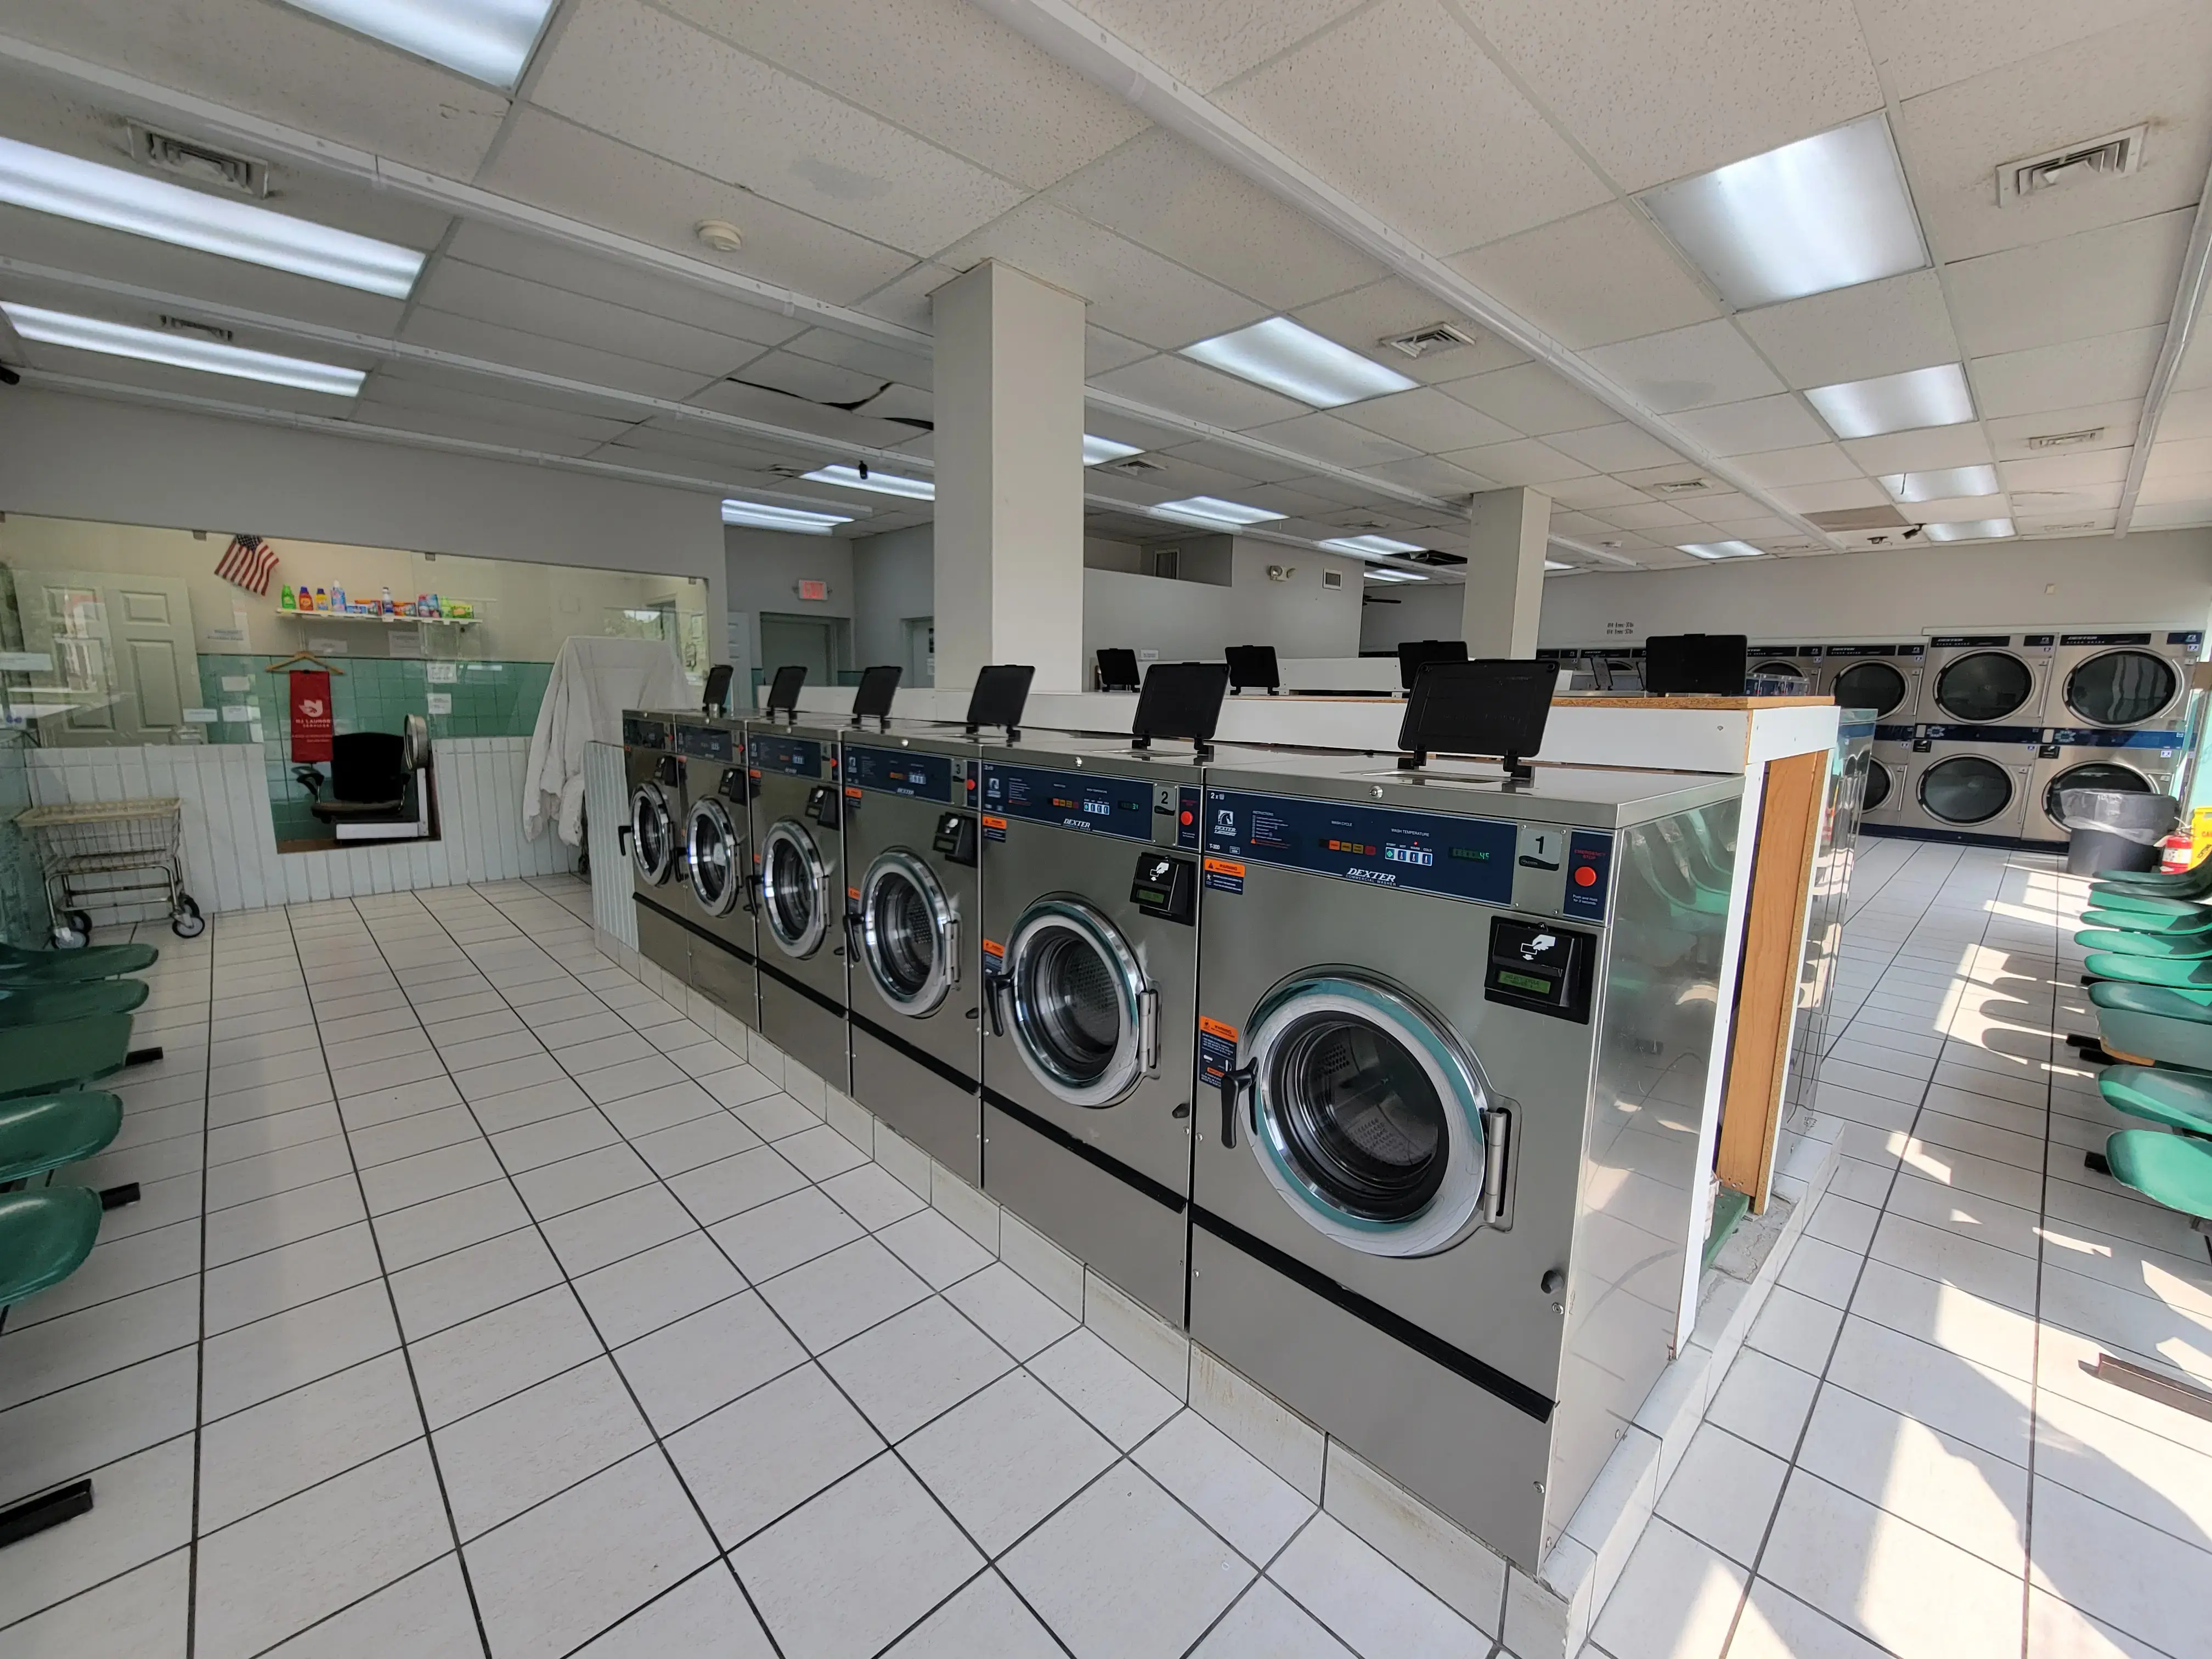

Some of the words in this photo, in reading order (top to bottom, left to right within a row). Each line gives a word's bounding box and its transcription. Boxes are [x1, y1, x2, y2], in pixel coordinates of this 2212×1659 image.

[1161, 791, 1169, 804] 2
[1063, 819, 1091, 828] DEXTER
[1535, 836, 1544, 854] 1
[1346, 868, 1396, 882] DEXTER
[1346, 874, 1374, 883] COMMERCIAL
